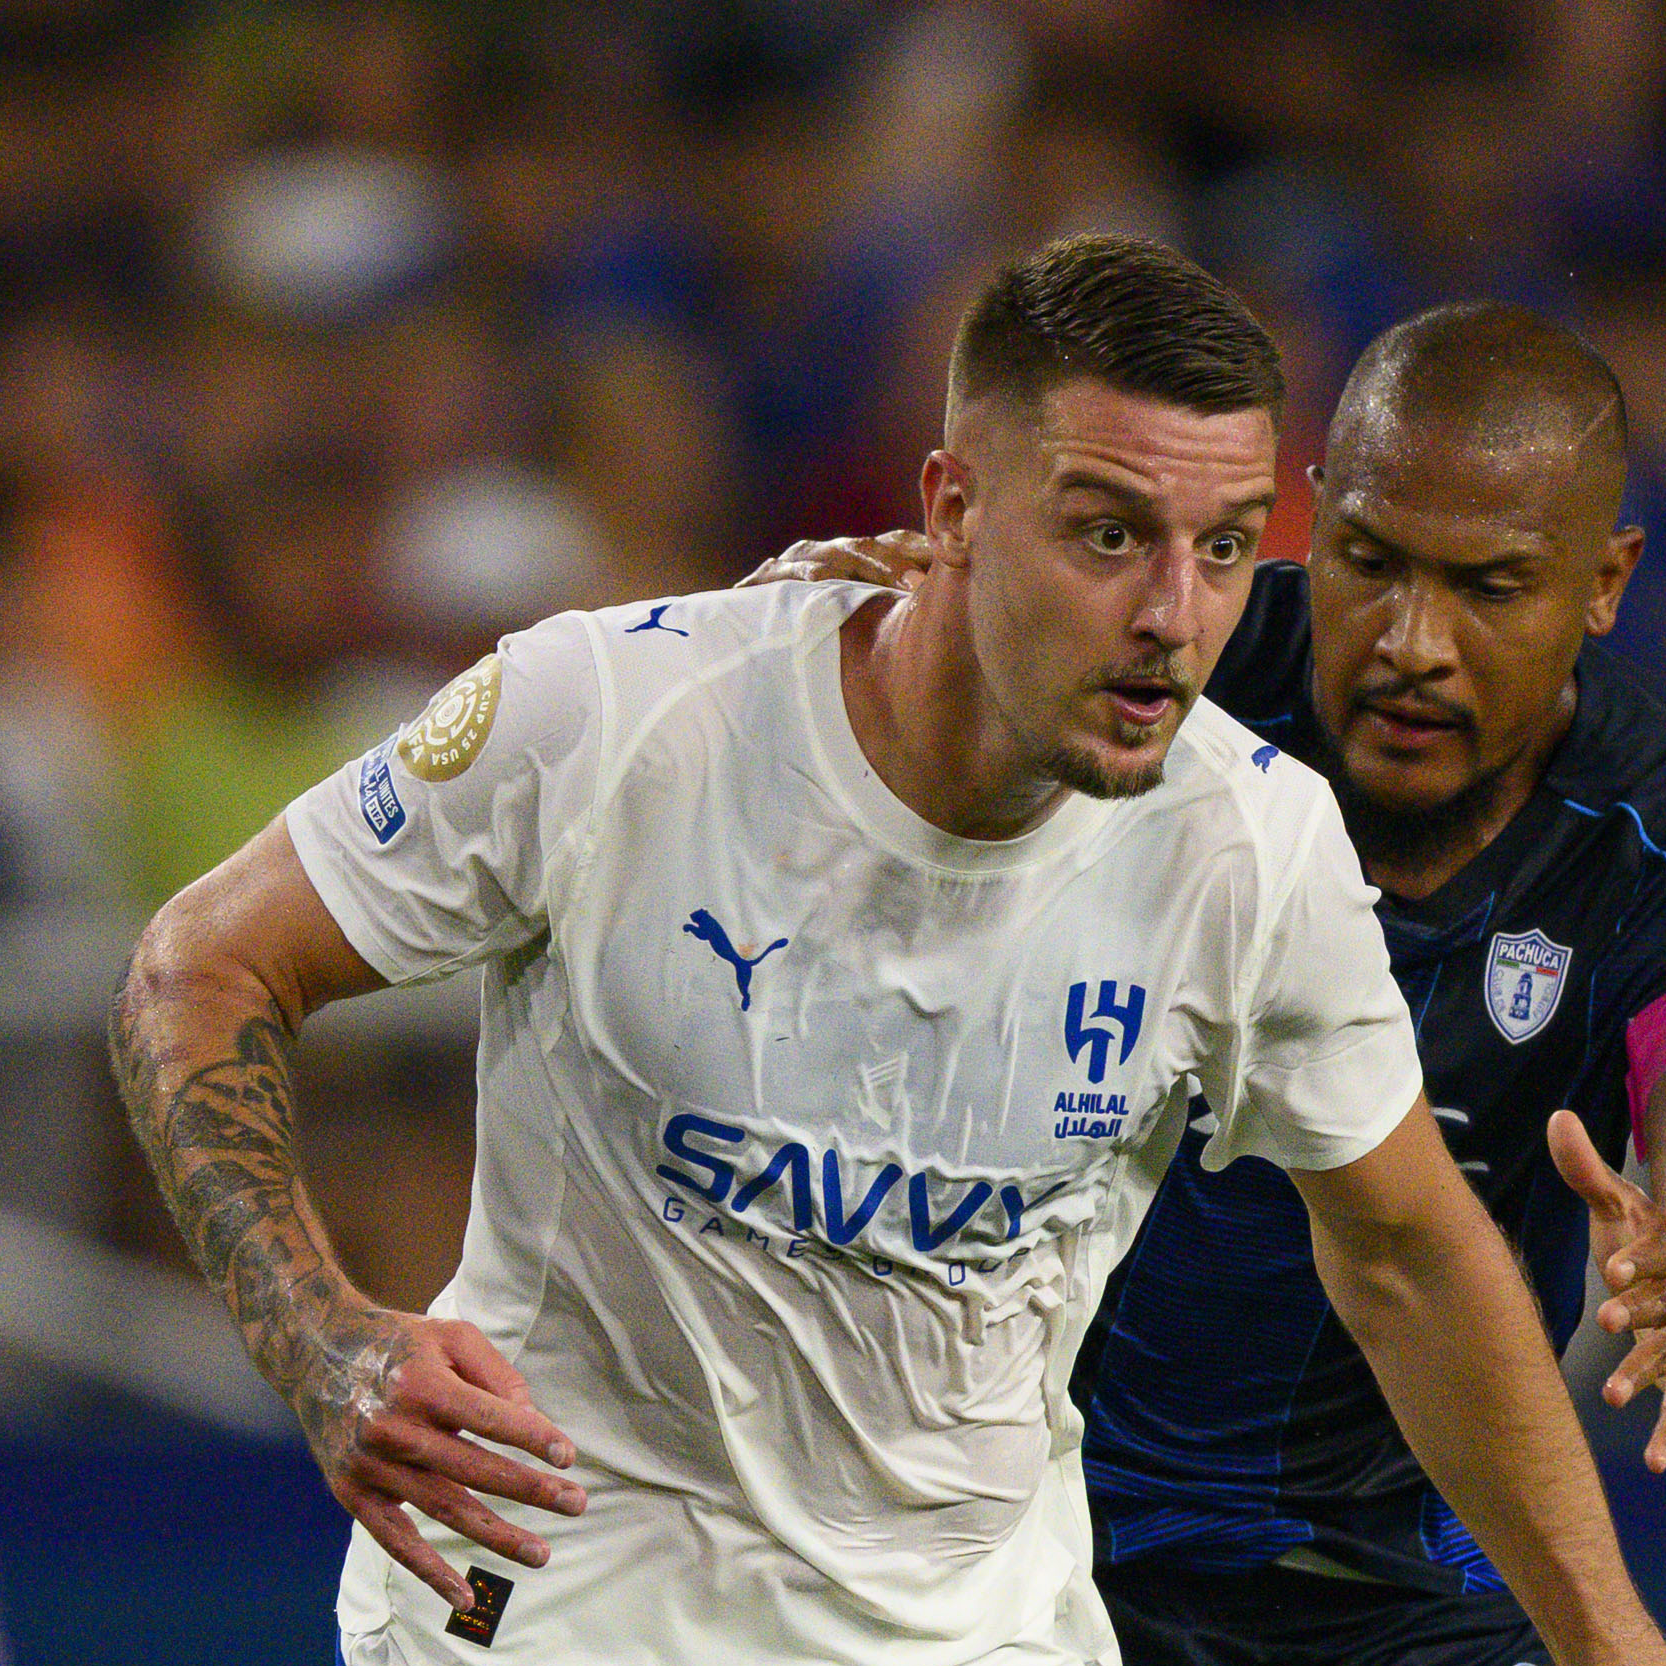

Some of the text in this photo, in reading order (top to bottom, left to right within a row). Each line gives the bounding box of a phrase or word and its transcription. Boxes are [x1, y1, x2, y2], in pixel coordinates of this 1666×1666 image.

[476, 690, 492, 724] CUP
[431, 748, 460, 766] USA
[369, 800, 384, 828] FIFA
[1499, 943, 1559, 968] PACHUCA
[1053, 1091, 1129, 1115] ALHILAL
[1054, 1116, 1123, 1139] الهلال
[656, 1113, 1071, 1252] SAVVY
